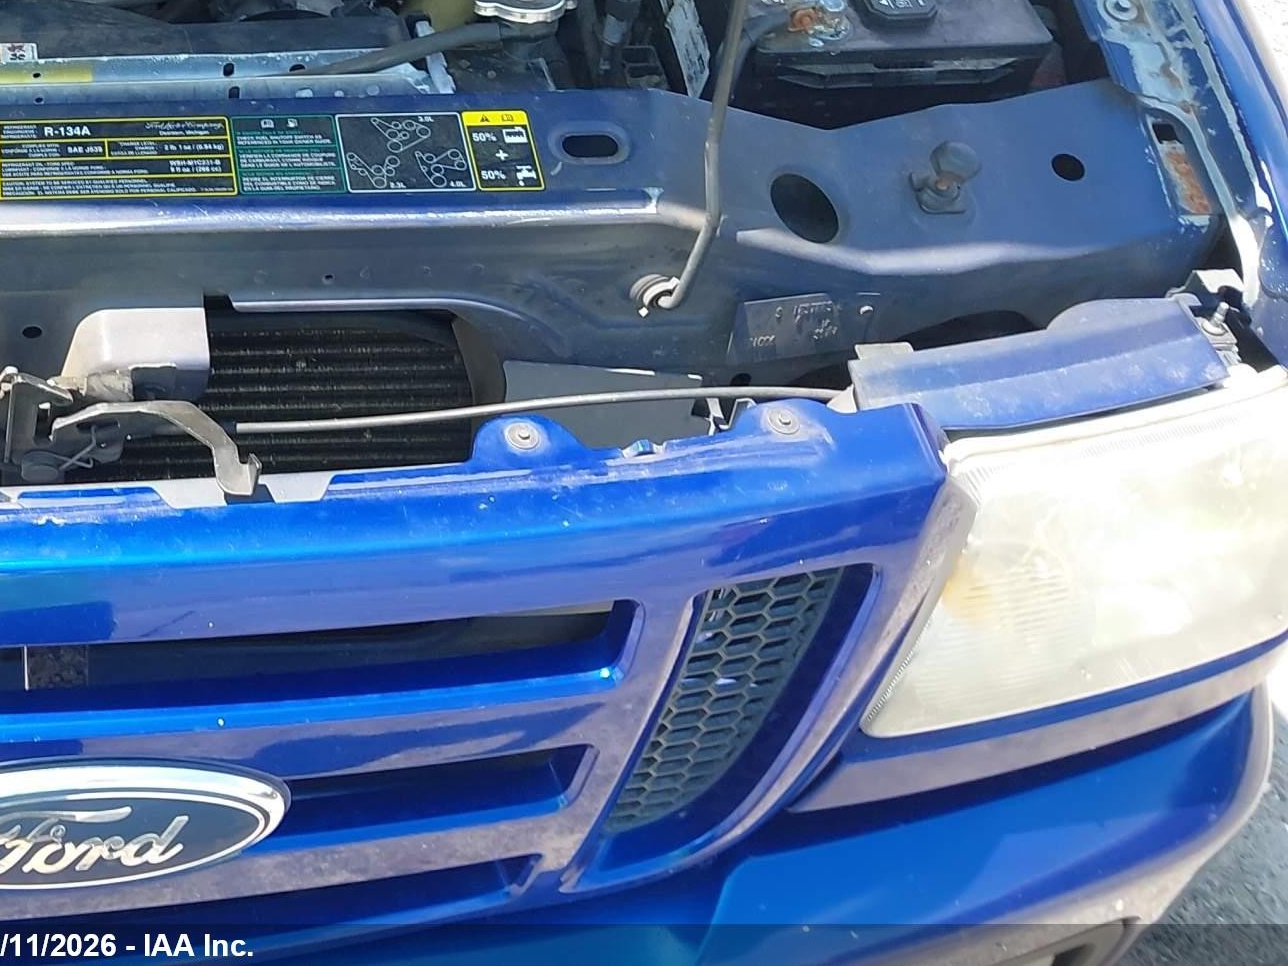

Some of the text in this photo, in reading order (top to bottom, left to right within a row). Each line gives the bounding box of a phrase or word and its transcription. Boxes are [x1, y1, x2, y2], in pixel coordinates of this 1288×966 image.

[44, 126, 91, 136] R-134A
[472, 133, 497, 142] 50%
[481, 171, 506, 180] 50%
